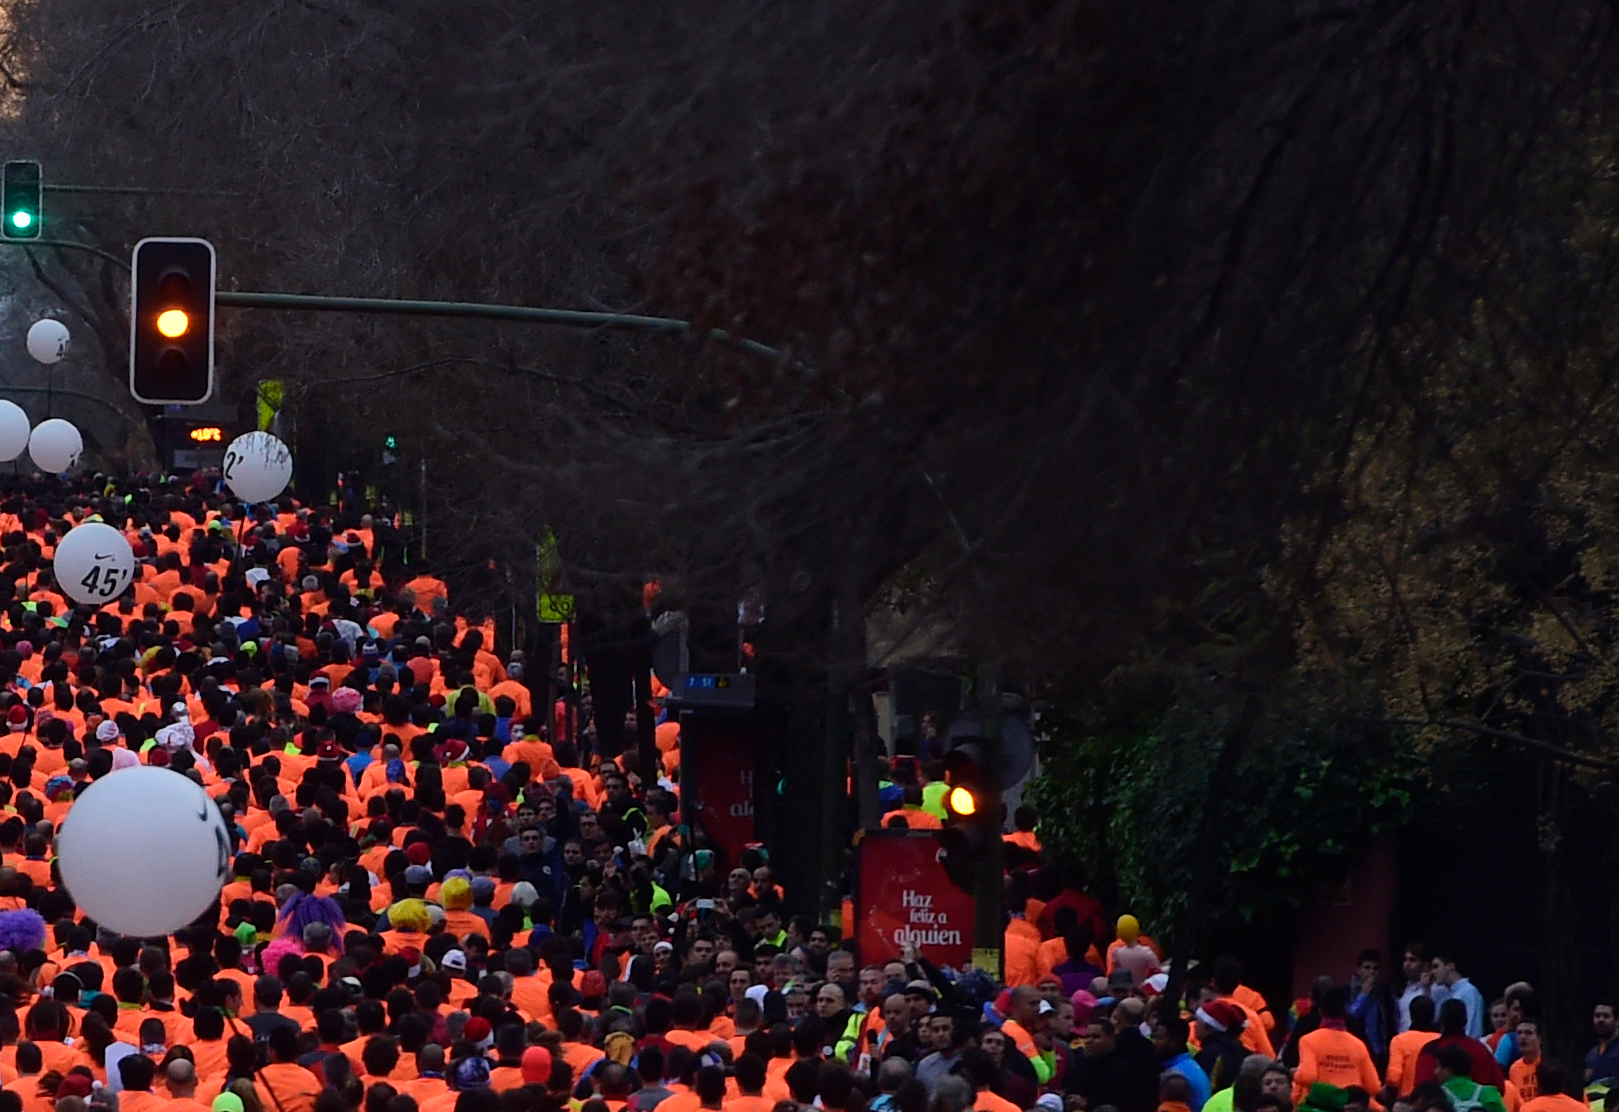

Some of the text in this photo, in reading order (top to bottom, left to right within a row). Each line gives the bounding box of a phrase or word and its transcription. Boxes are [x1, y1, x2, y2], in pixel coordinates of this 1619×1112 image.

[80, 565, 128, 597] 45'
[902, 889, 933, 908] Haz
[937, 912, 947, 924] a
[893, 924, 962, 949] alguien
